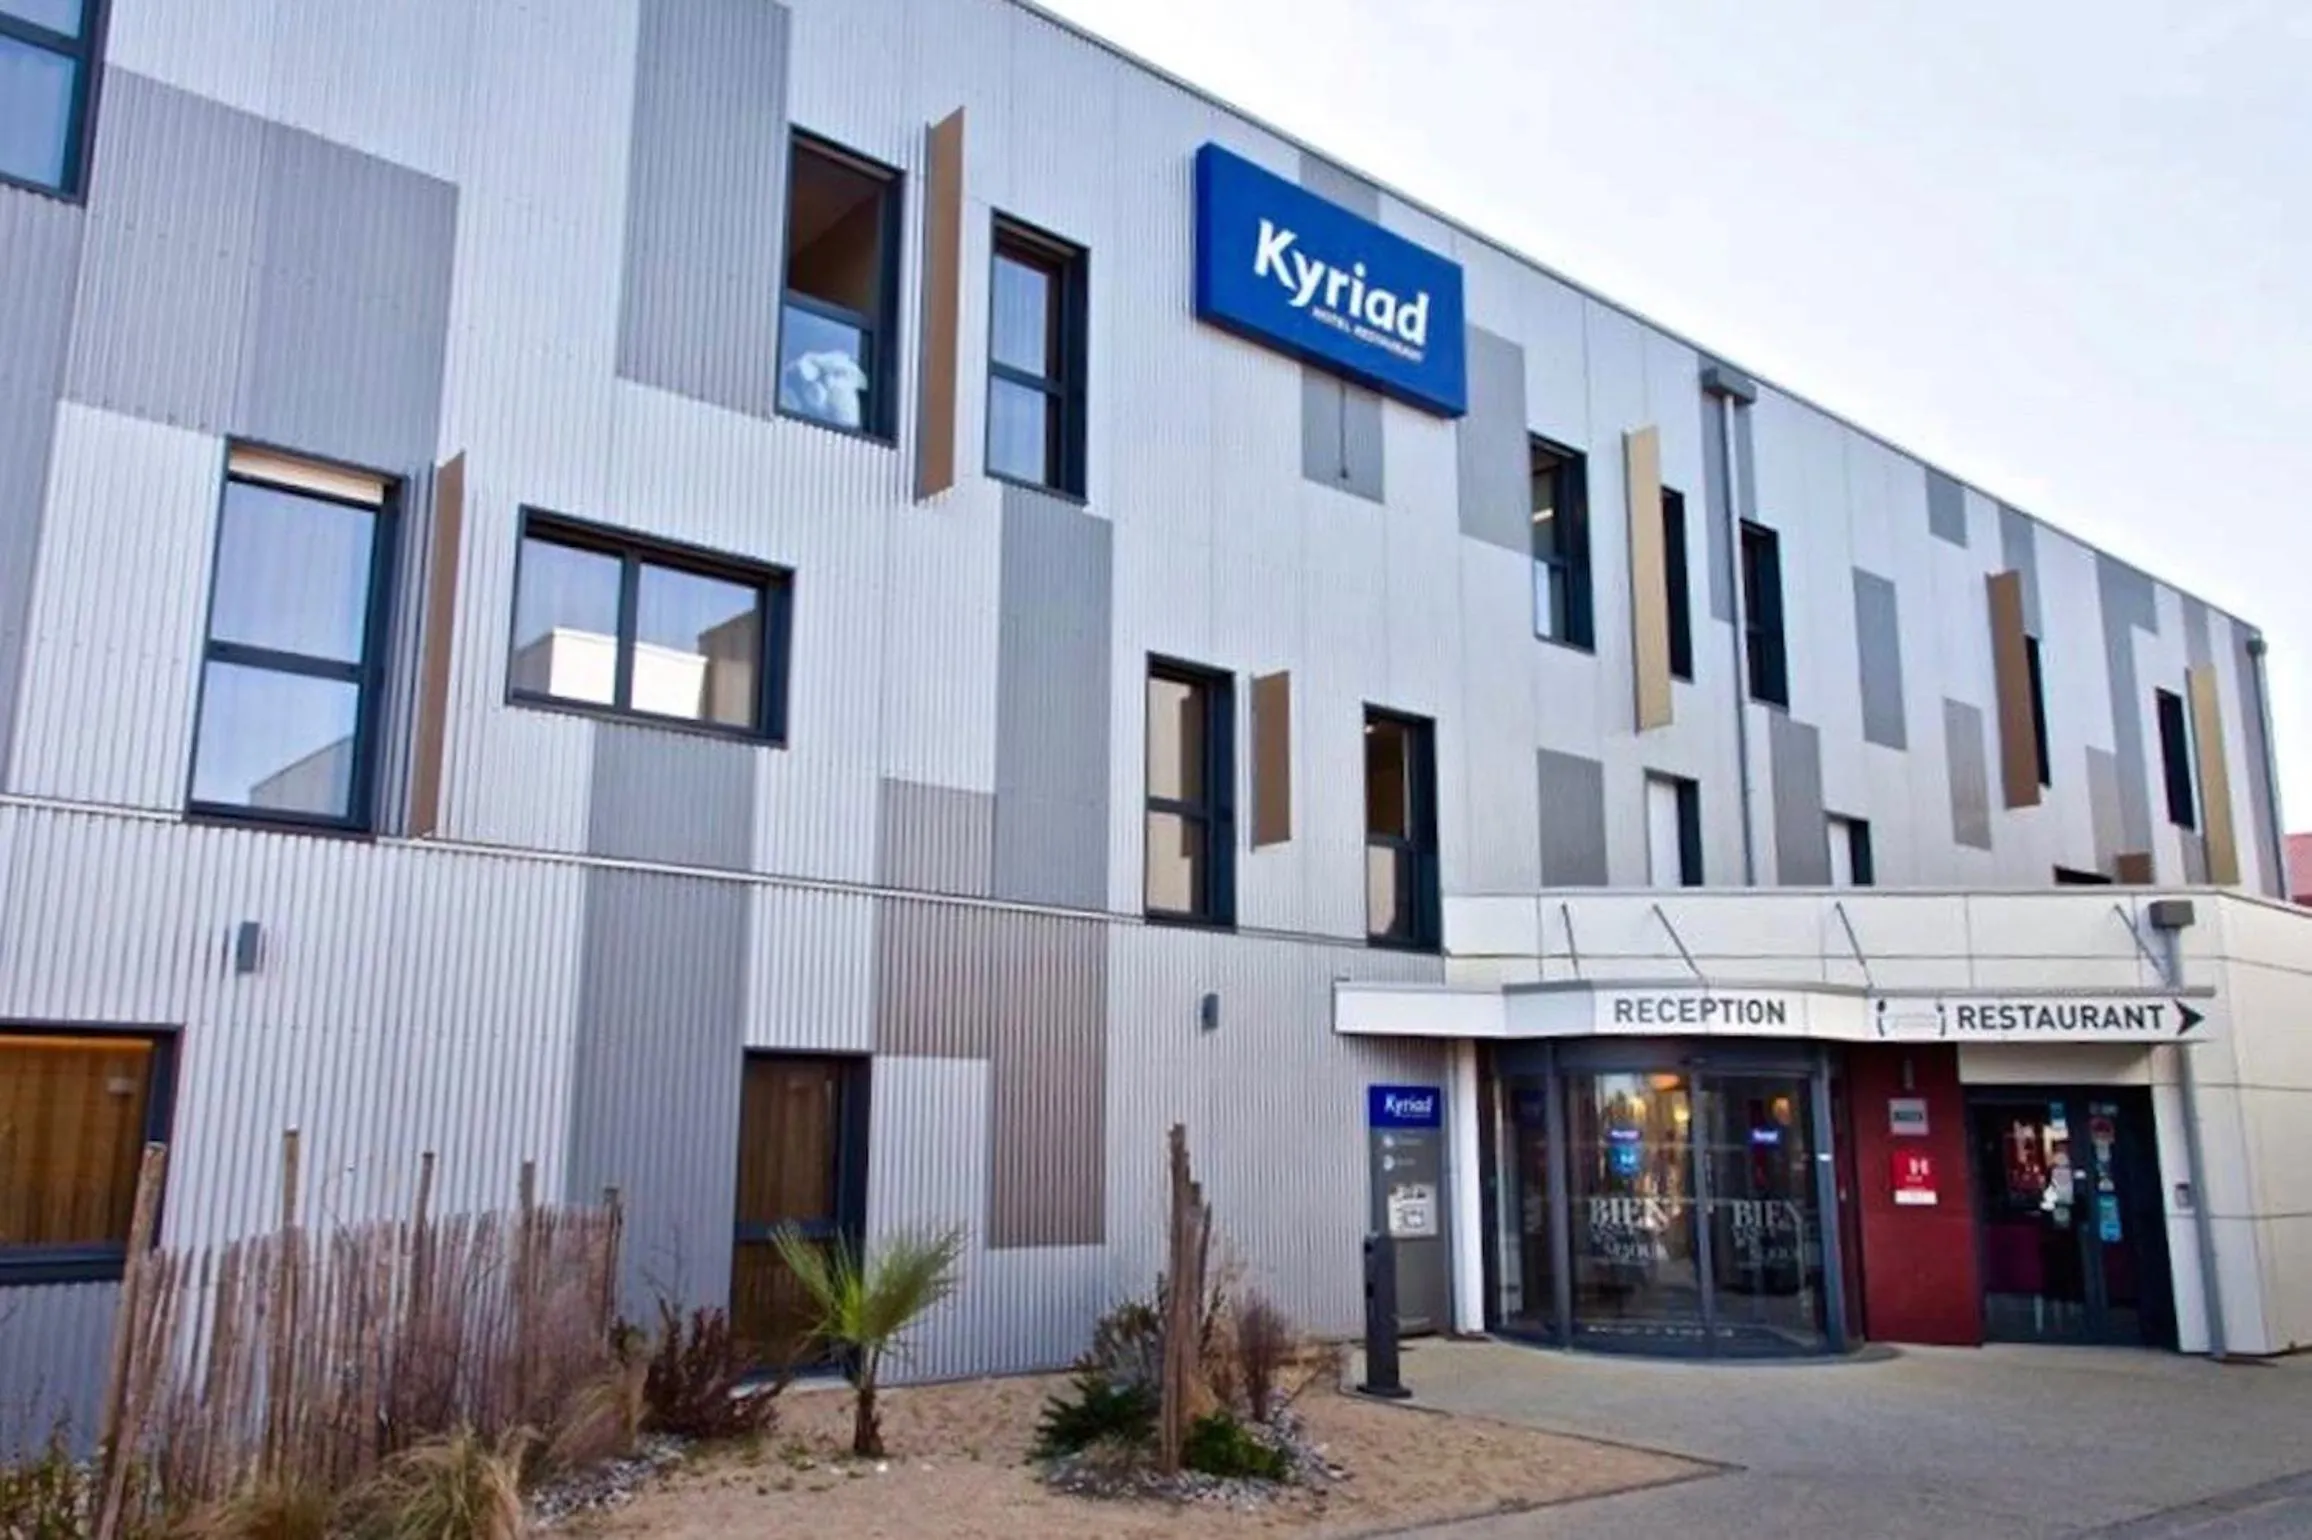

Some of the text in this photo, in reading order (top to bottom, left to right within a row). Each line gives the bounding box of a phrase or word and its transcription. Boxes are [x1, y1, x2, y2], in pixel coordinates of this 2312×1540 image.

[1254, 216, 1430, 347] Kyriad
[1614, 998, 1786, 1025] RECEPTION
[1957, 1005, 2165, 1030] RESTAURANT
[1384, 1093, 1433, 1116] Kyriad
